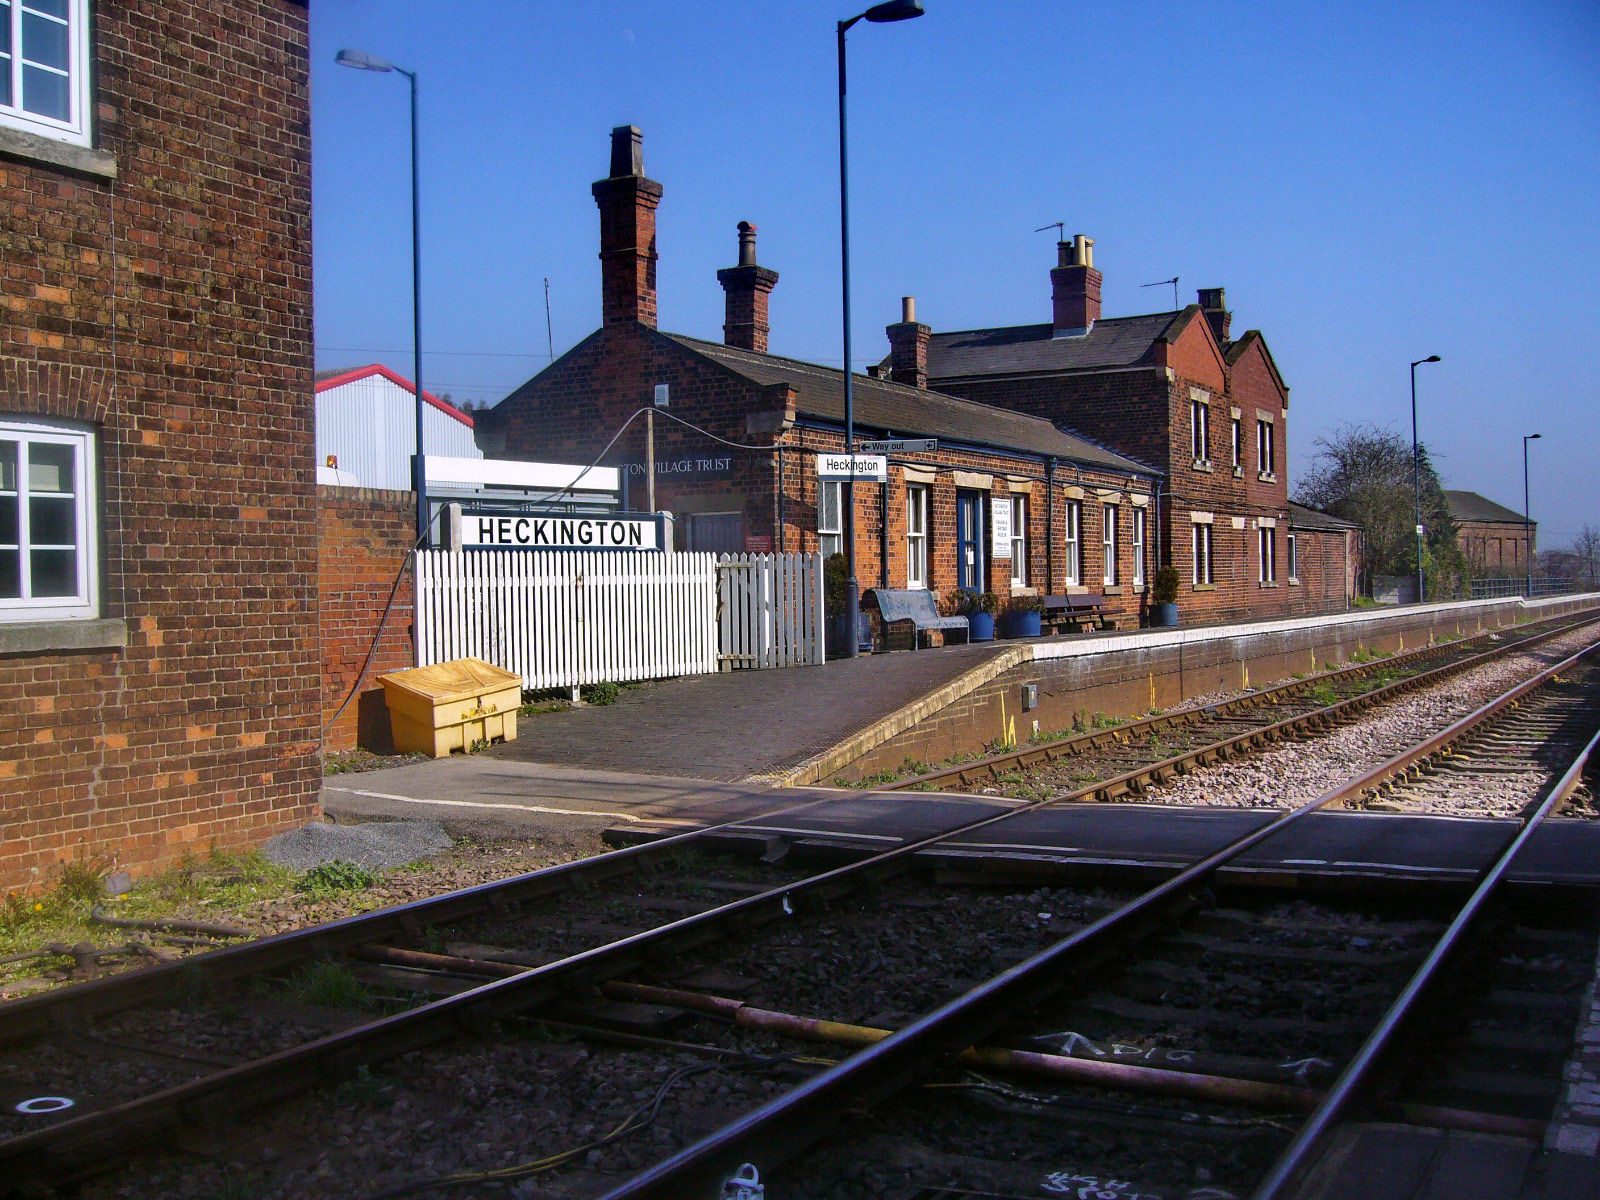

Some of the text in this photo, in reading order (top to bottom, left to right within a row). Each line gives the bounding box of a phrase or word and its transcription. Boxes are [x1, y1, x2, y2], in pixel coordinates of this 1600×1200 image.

[872, 442, 904, 452] Way out
[695, 458, 732, 472] TRUST
[826, 458, 879, 473] Heckington
[479, 517, 642, 546] HECKINGTON
